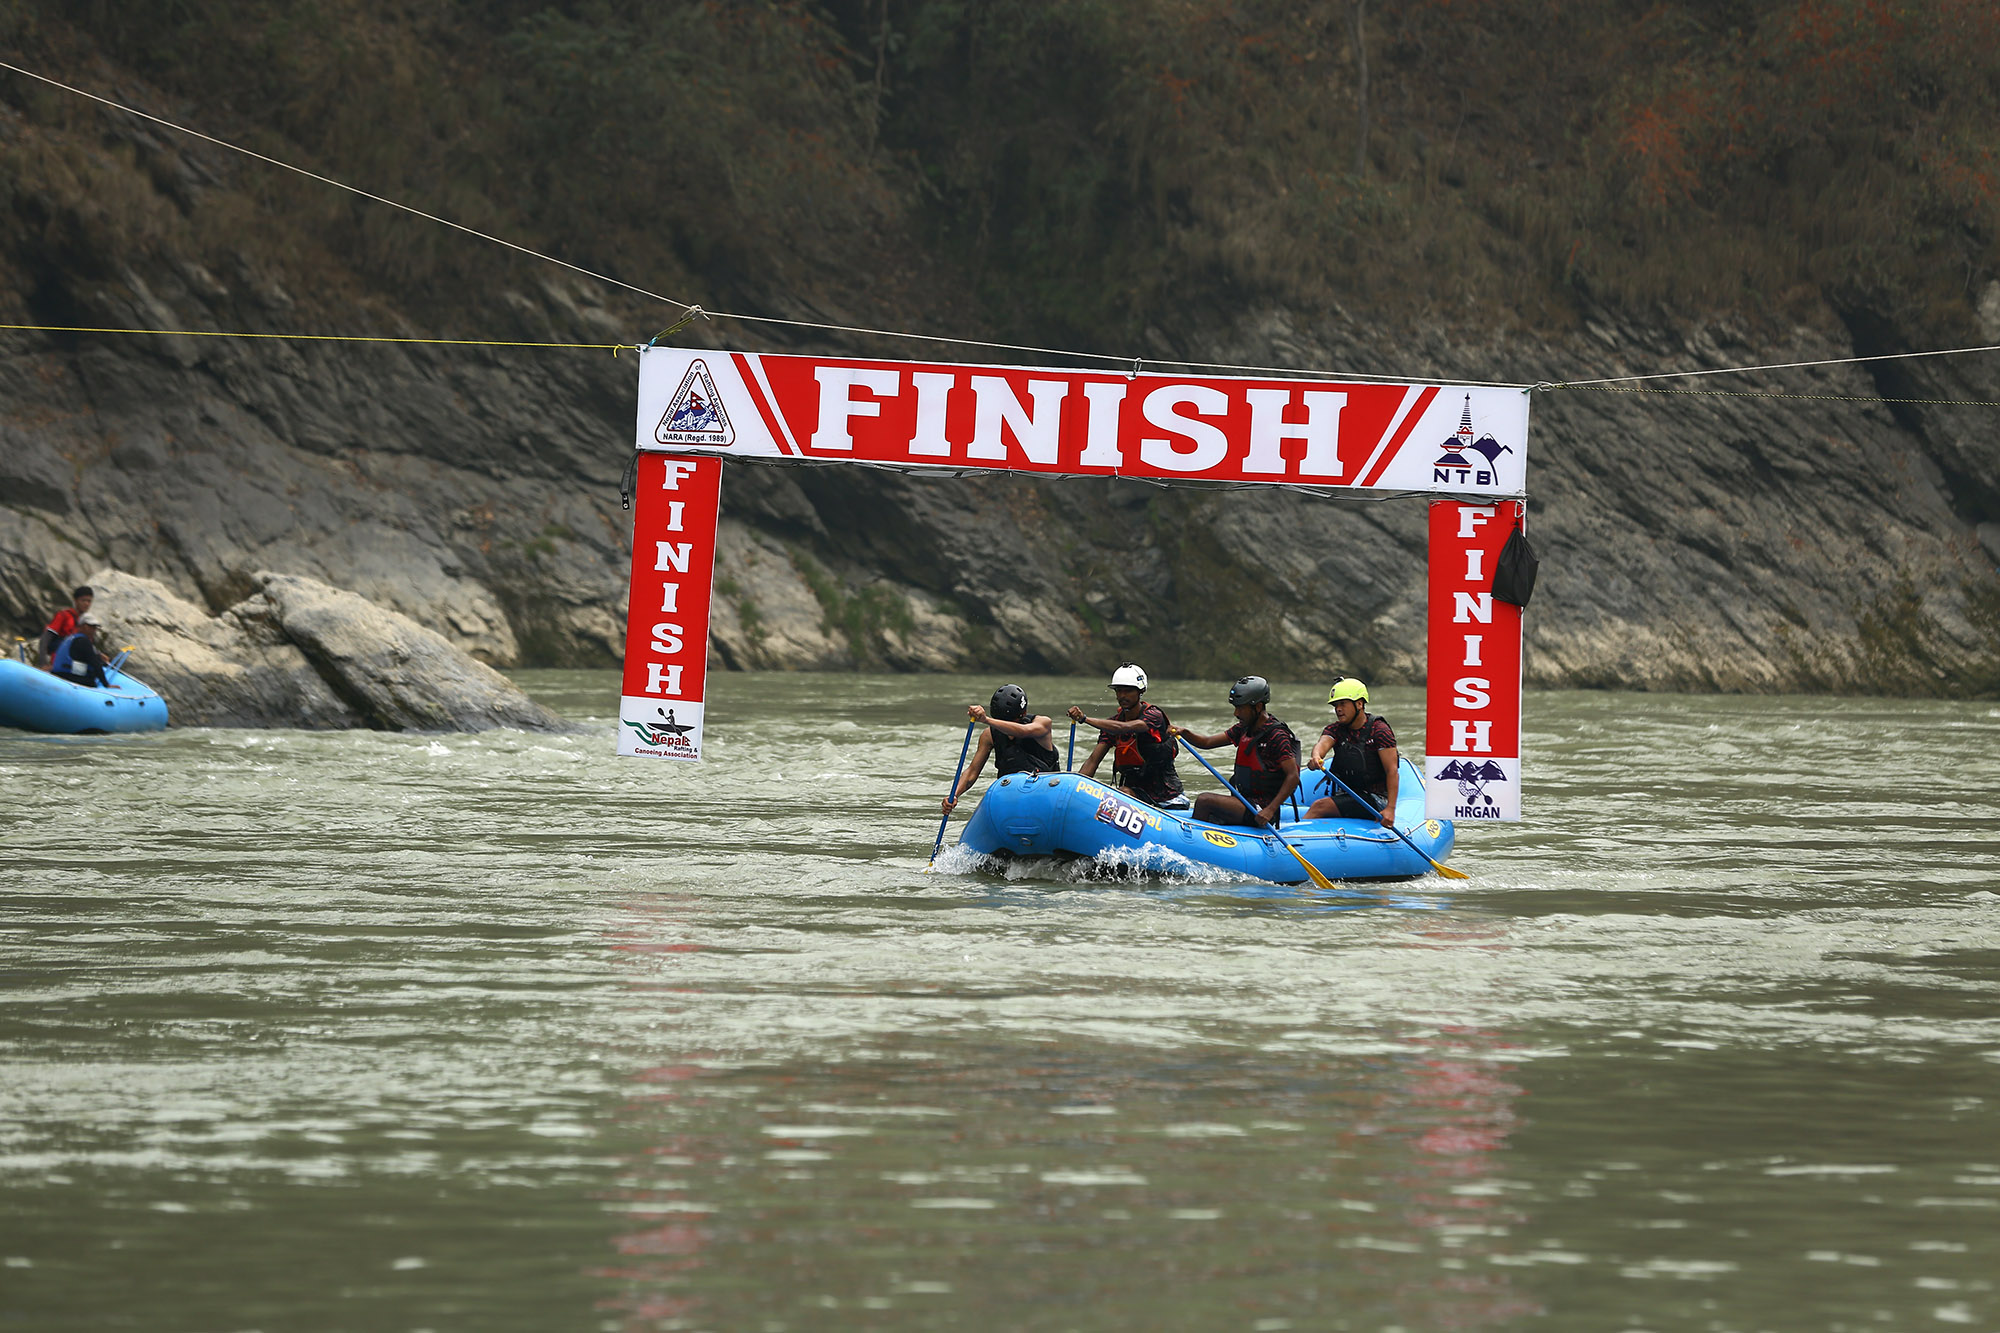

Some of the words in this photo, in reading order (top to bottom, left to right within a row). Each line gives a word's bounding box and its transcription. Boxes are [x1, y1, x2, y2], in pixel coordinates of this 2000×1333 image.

[662, 406, 675, 426] Nepal
[672, 371, 695, 408] Association
[702, 373, 715, 398] Rafting
[713, 397, 728, 427] Agencies
[811, 366, 1348, 477] FINISH
[685, 434, 707, 442] (Regd.
[709, 435, 727, 443] 1989)
[1434, 468, 1491, 485] NTB
[645, 459, 697, 695] FINISH
[1450, 507, 1495, 752] FINISH
[651, 733, 685, 747] Nepal
[634, 747, 662, 757] Canoeing
[663, 750, 698, 759] Association
[674, 745, 693, 753] Rafting
[1455, 806, 1500, 818] HRGAN
[1114, 806, 1144, 834] 06
[1205, 832, 1235, 846] NRS
